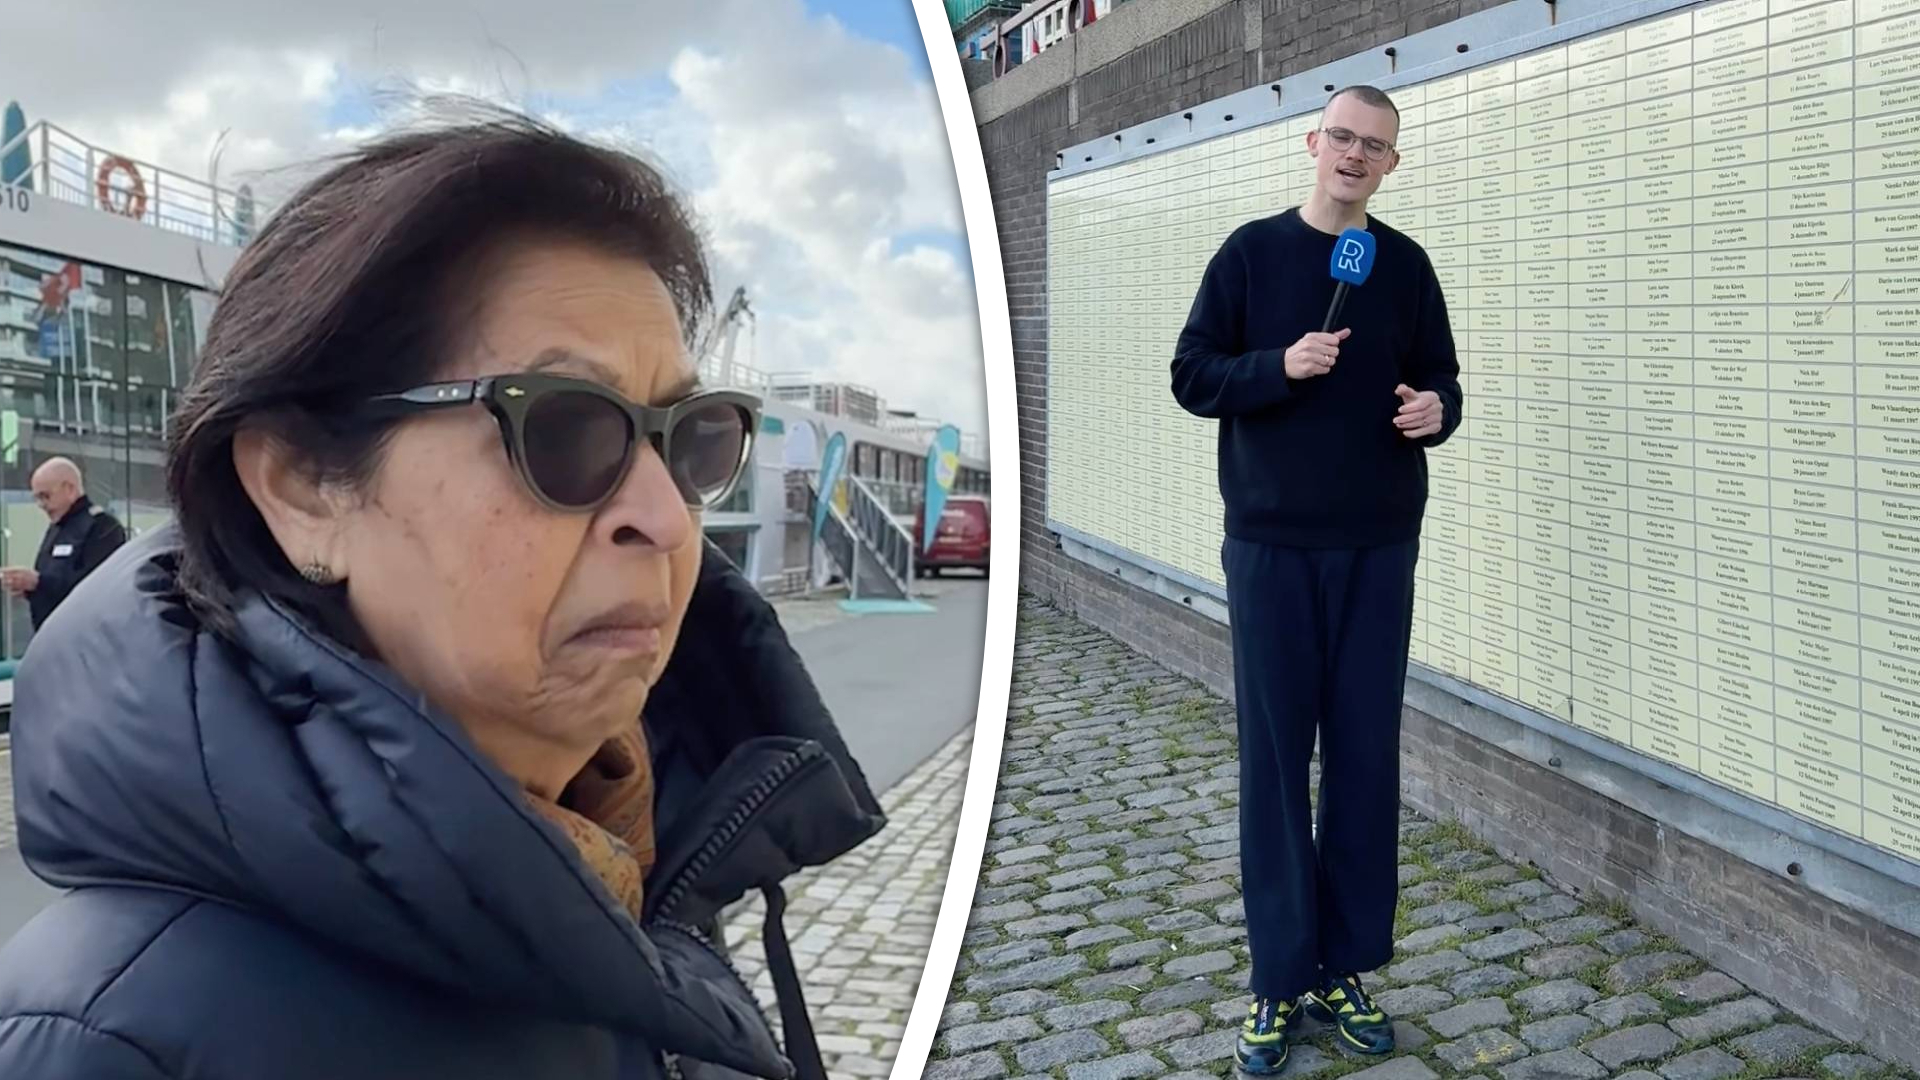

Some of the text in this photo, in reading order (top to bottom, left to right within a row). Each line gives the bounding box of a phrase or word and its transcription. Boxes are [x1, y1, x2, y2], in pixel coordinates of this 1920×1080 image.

[0, 187, 29, 213] 10
[1890, 192, 1905, 200] maart
[1338, 239, 1364, 273] R
[1892, 447, 1907, 455] maart
[1893, 480, 1908, 488] maart
[1881, 500, 1896, 508] Frank
[1893, 511, 1908, 520] maart
[1894, 544, 1910, 552] maart
[1894, 577, 1909, 587] maart
[1895, 608, 1910, 618] maart
[1896, 642, 1908, 651] april
[1897, 675, 1909, 684] april
[1897, 707, 1909, 717] april
[1898, 741, 1911, 751] april
[1899, 773, 1911, 784] april
[1899, 807, 1911, 818] april
